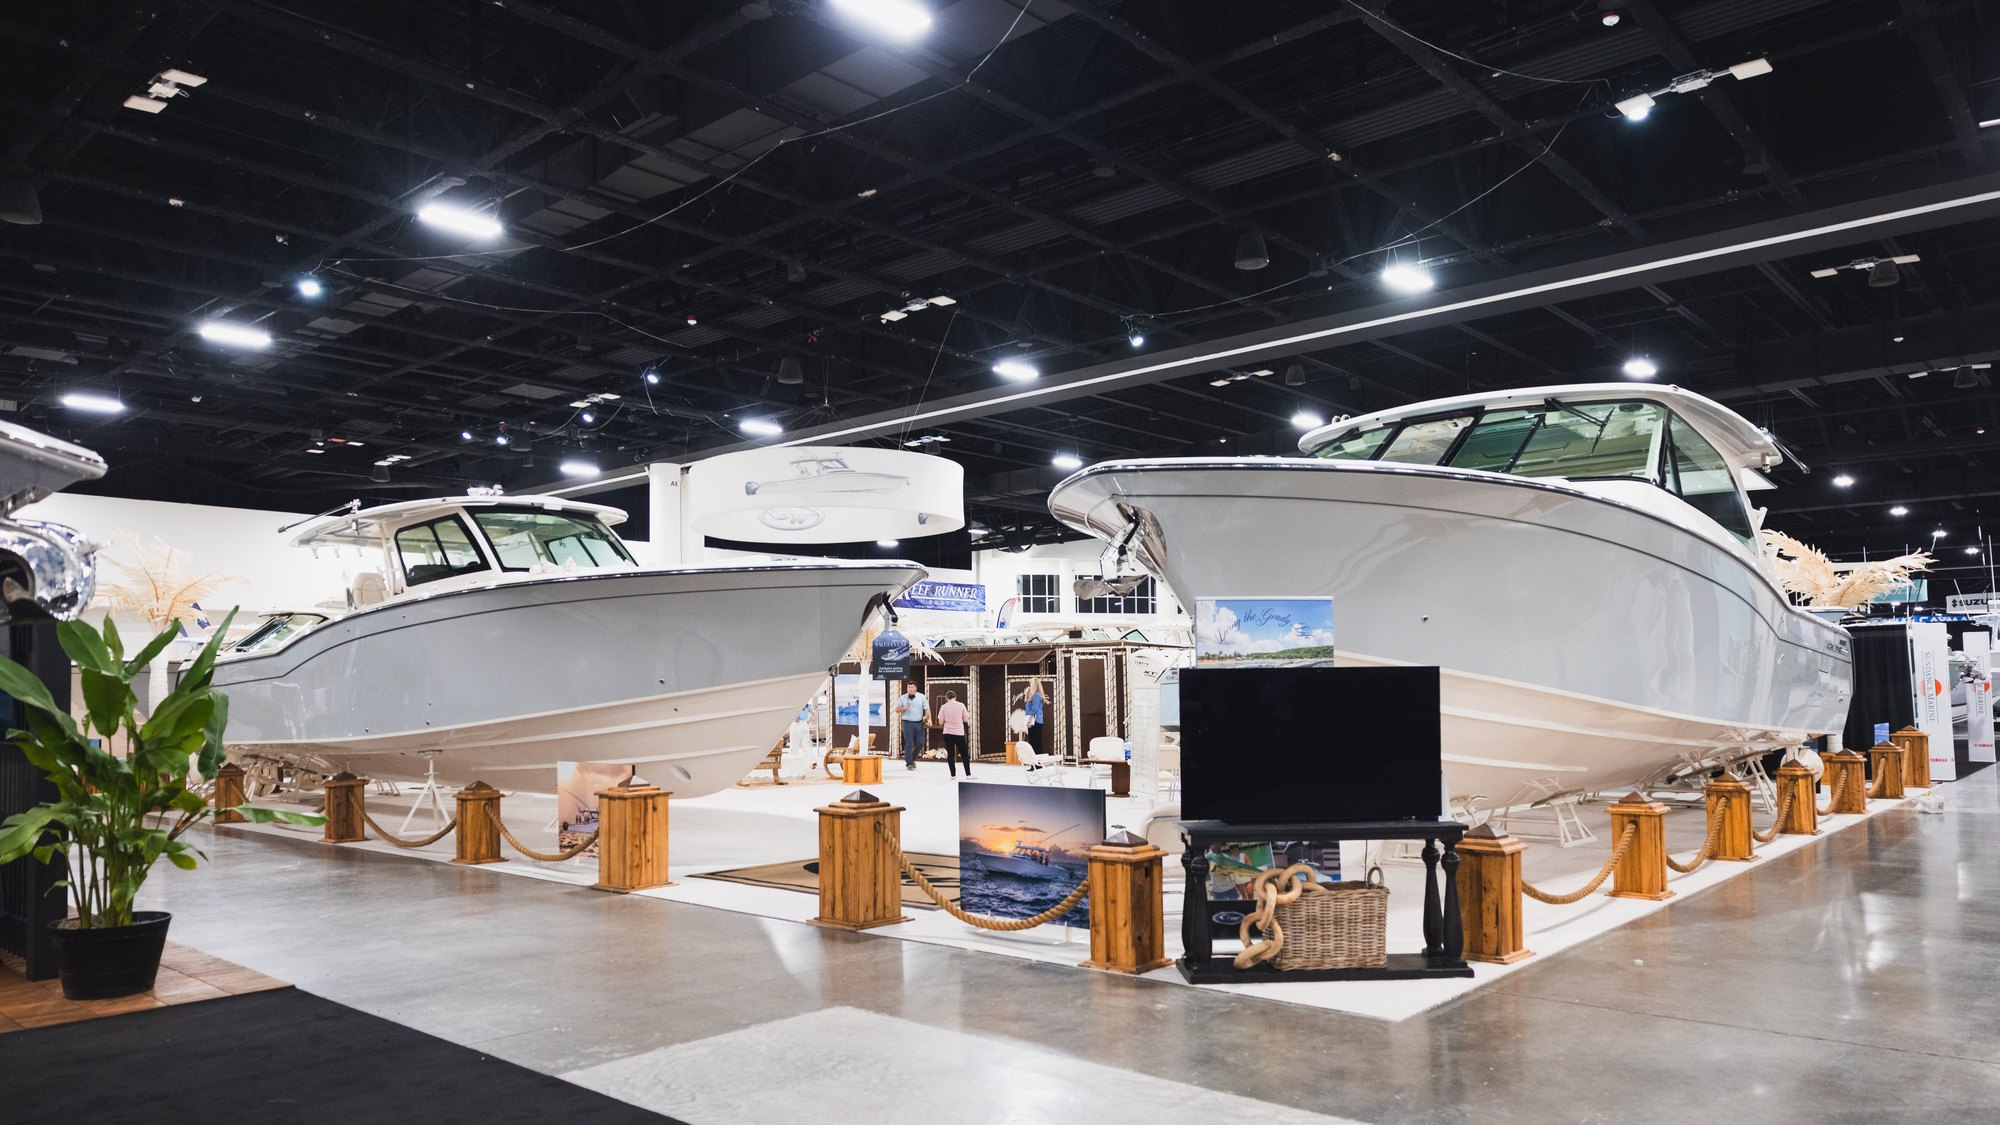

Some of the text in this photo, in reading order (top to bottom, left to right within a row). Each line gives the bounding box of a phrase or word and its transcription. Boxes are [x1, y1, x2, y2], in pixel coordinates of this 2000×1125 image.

[934, 585, 978, 599] RUNNER
[1243, 608, 1256, 623] the
[1255, 607, 1292, 628] Grady
[1924, 651, 1936, 723] SUNDANCE MARINE
[1977, 688, 1985, 714] MARINE
